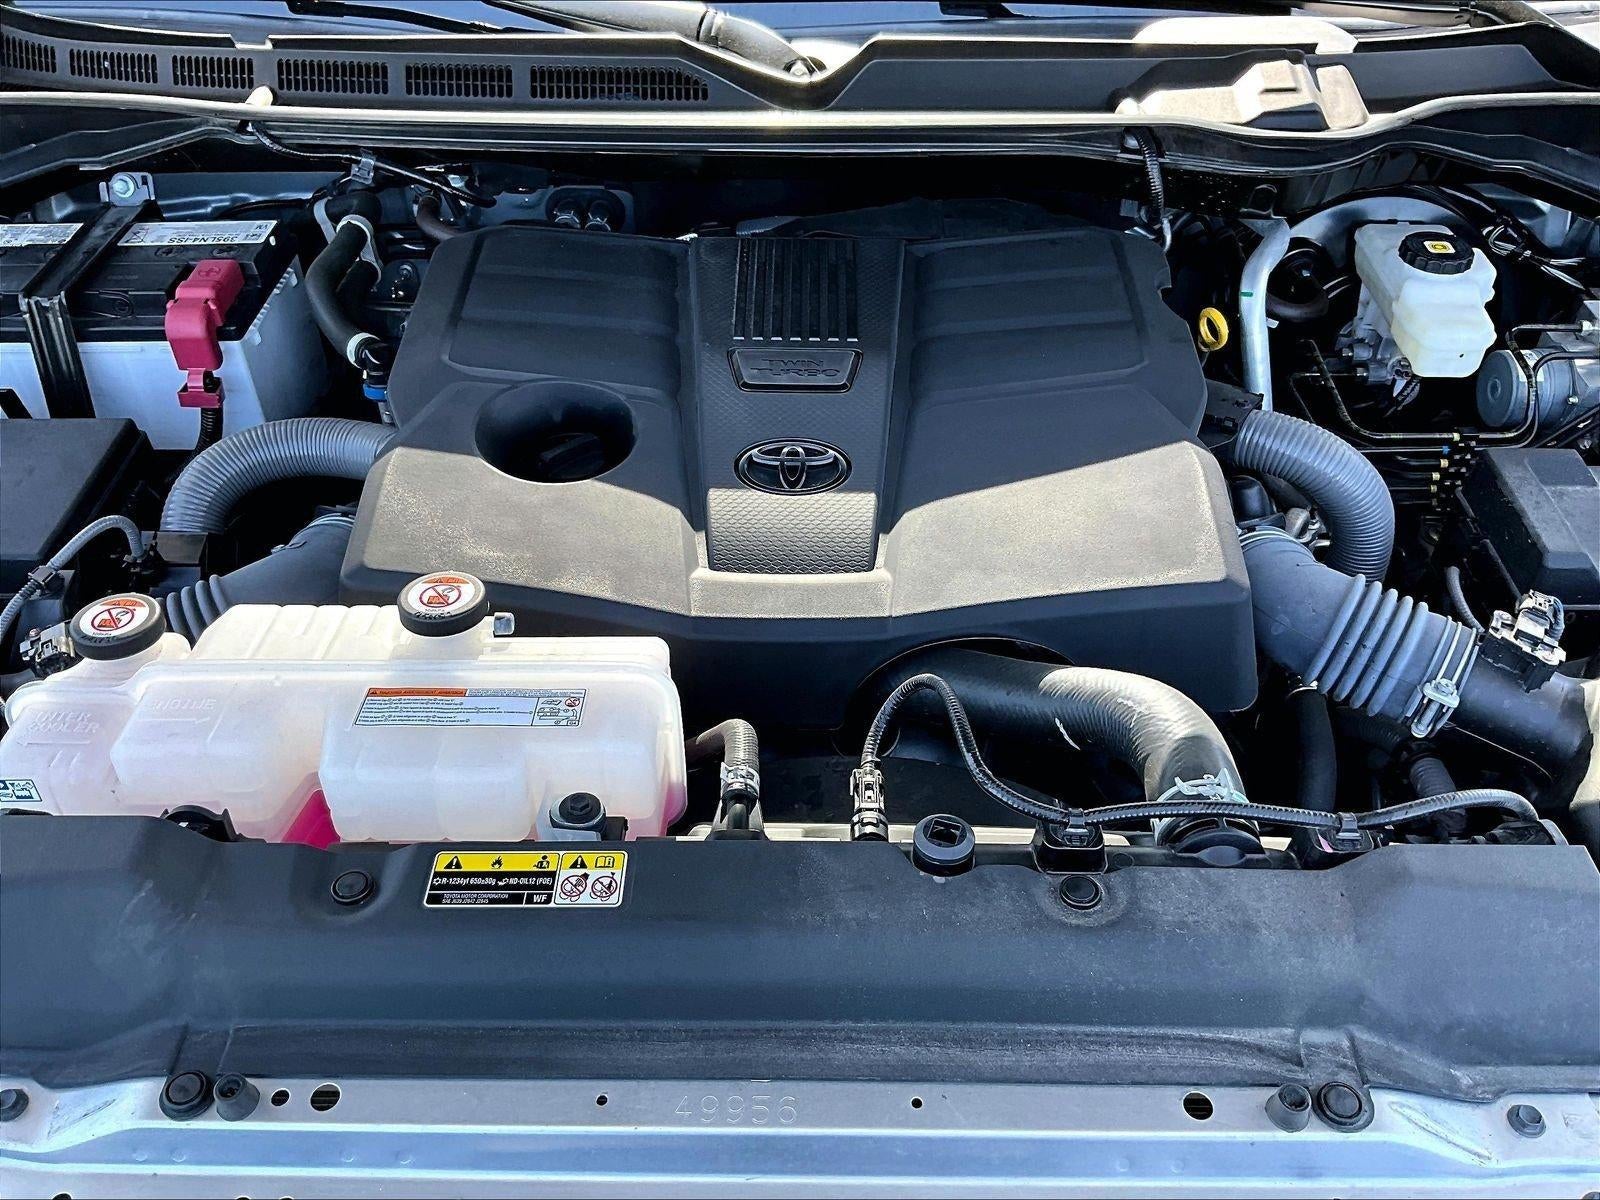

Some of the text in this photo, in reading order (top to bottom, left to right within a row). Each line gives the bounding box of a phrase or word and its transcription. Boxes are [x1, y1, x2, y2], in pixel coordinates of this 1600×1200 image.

[760, 358, 824, 368] TWIN
[749, 367, 841, 377] TURBO
[441, 877, 470, 887] R-1234yf
[533, 894, 548, 903] WF
[674, 1094, 798, 1125] 49956
